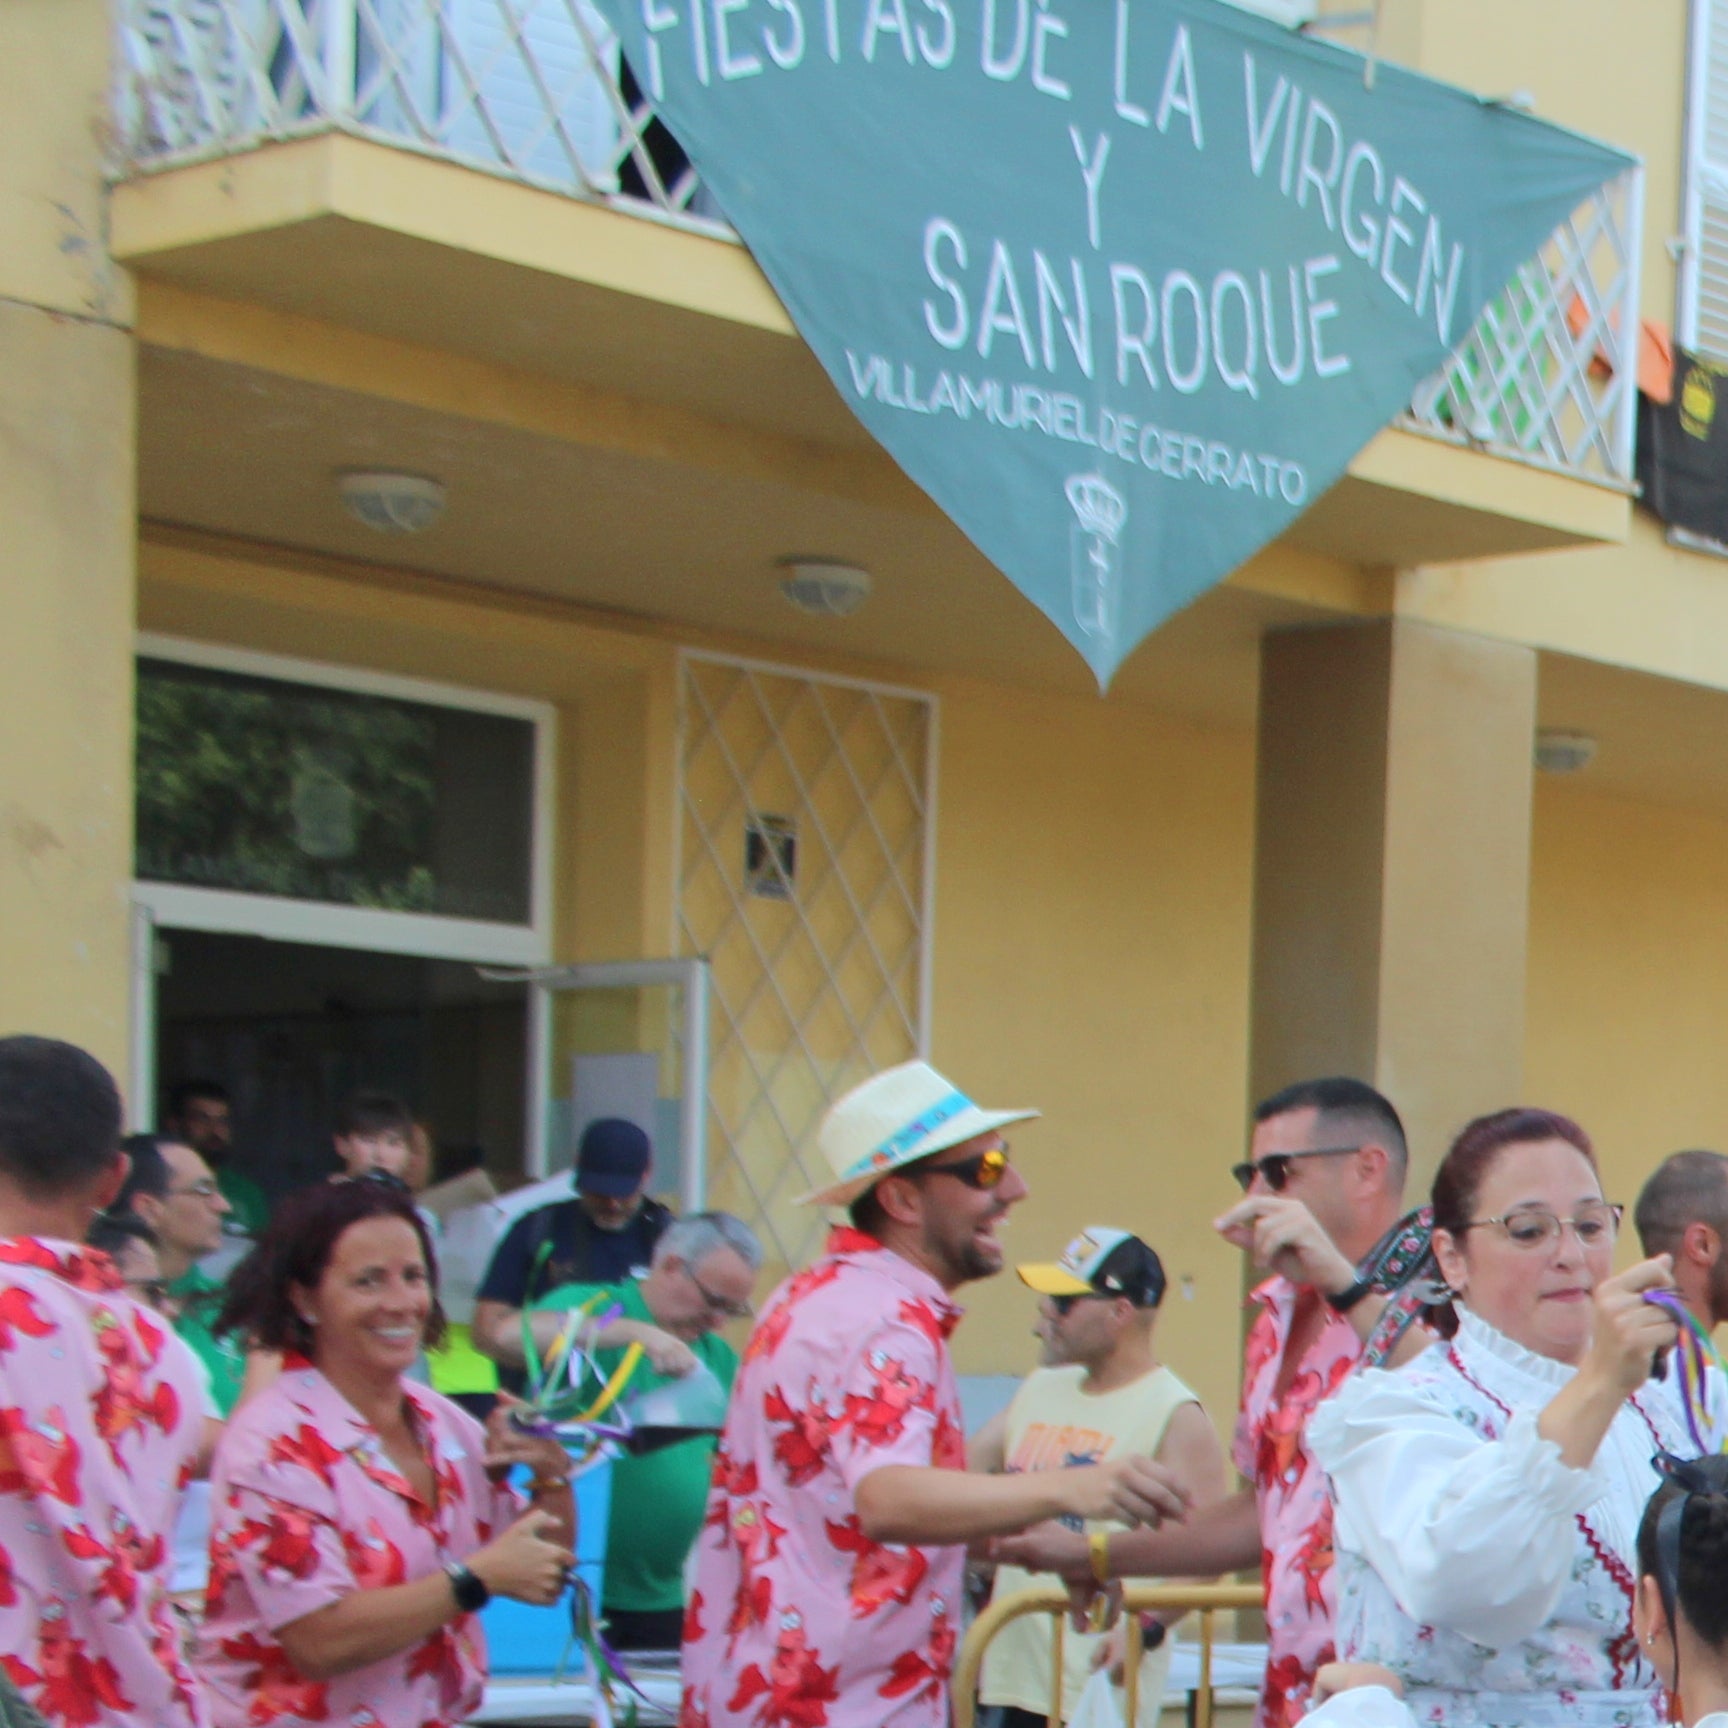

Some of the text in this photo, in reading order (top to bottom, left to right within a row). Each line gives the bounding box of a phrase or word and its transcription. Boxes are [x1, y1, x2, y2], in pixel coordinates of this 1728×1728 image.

[980, 0, 1072, 100] DE
[1114, 0, 1204, 151] LA
[1243, 50, 1464, 348] VIRGEN
[1068, 124, 1112, 251] Y
[923, 215, 1352, 401] SAN ROQUE
[844, 347, 1308, 507] VILLAMURIEL DE CERRATO
